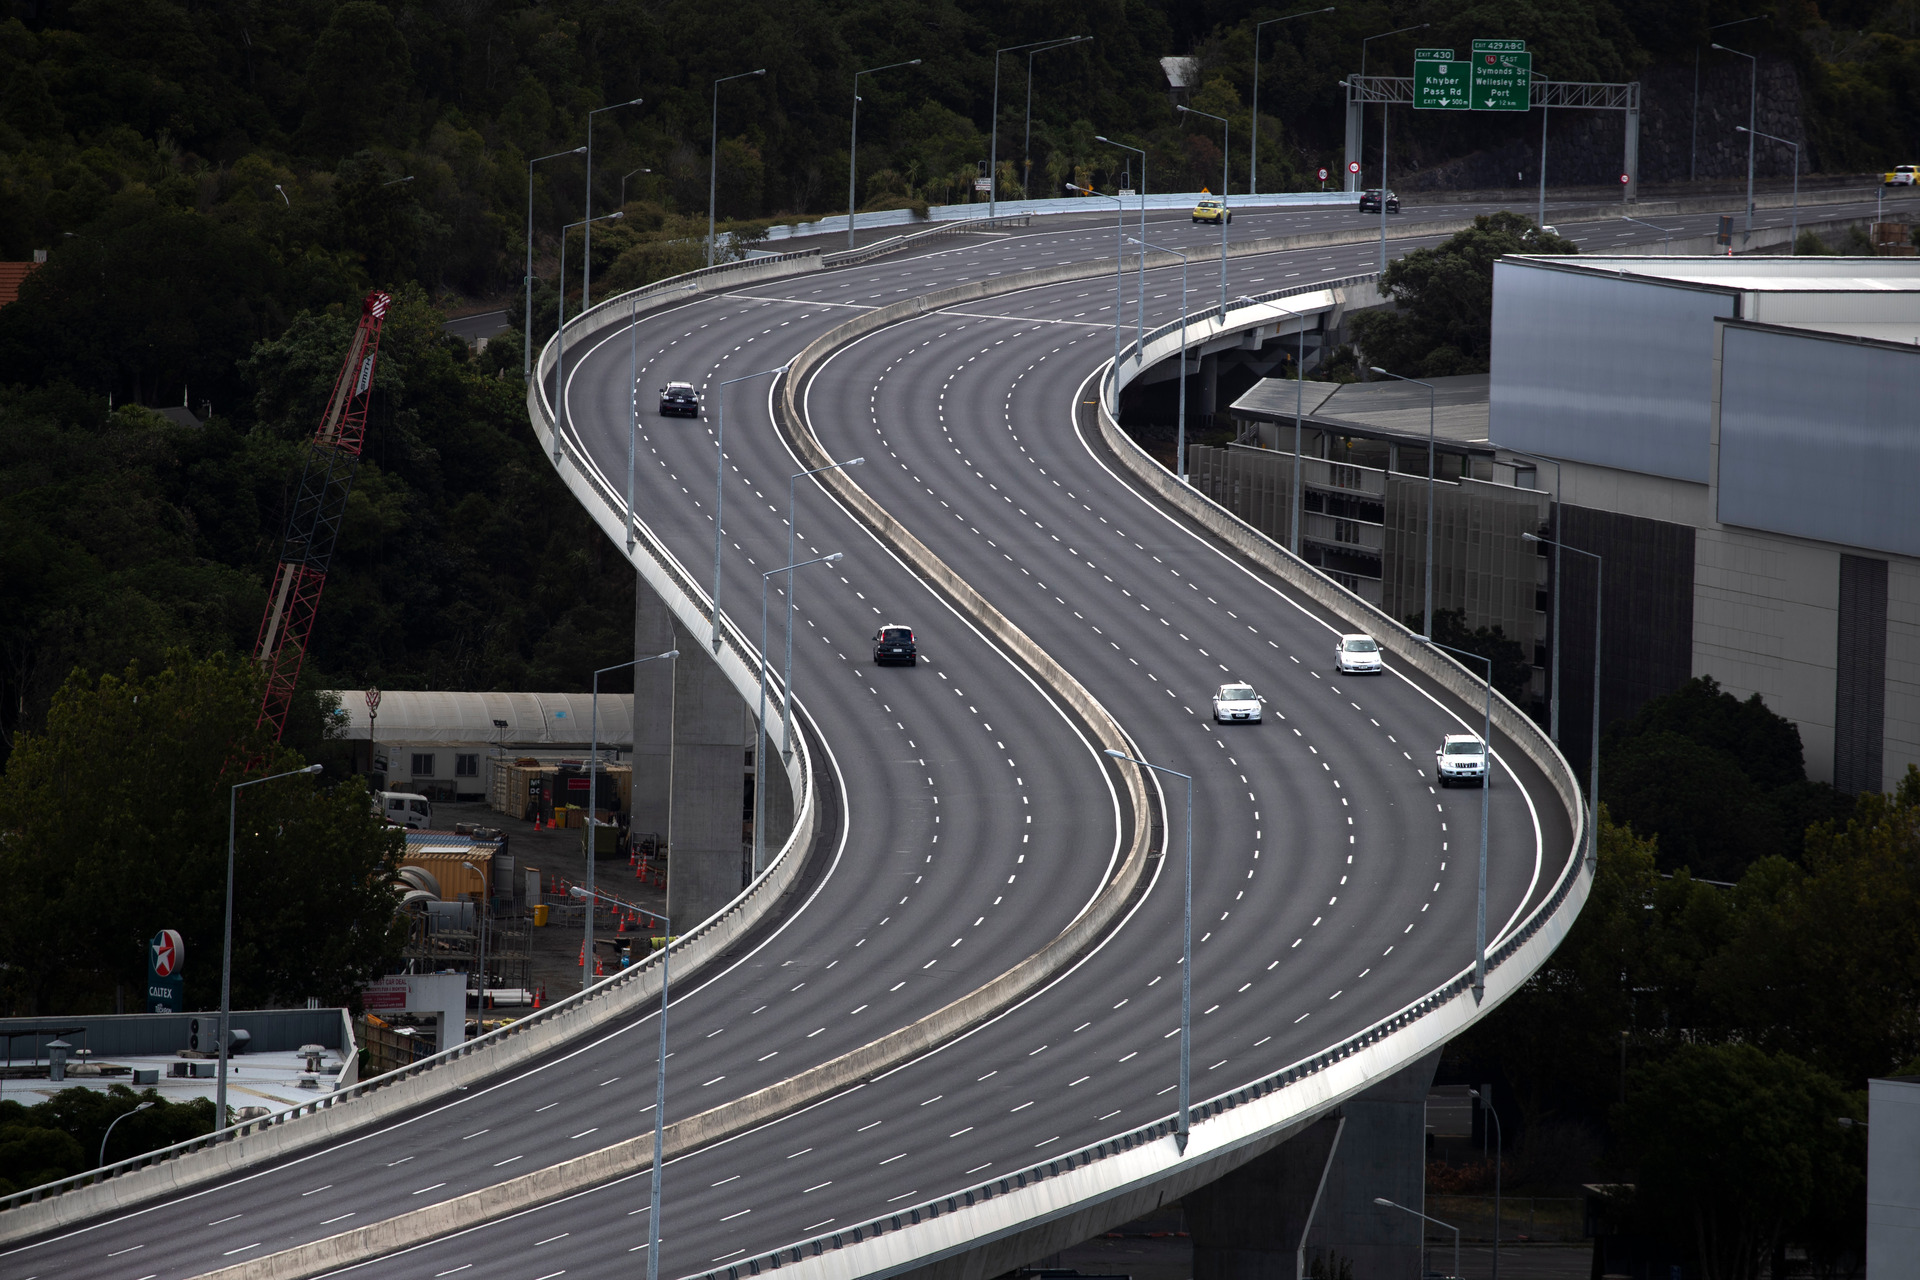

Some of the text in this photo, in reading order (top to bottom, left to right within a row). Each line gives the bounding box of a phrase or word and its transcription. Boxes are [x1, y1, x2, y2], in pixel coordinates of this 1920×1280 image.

[1477, 67, 1512, 76] Symonds
[1426, 76, 1459, 86] Khyber
[1476, 78, 1513, 87] Wellesley
[1491, 88, 1510, 97] Port
[360, 357, 371, 390] SMITH
[149, 986, 172, 999] CALTEX
